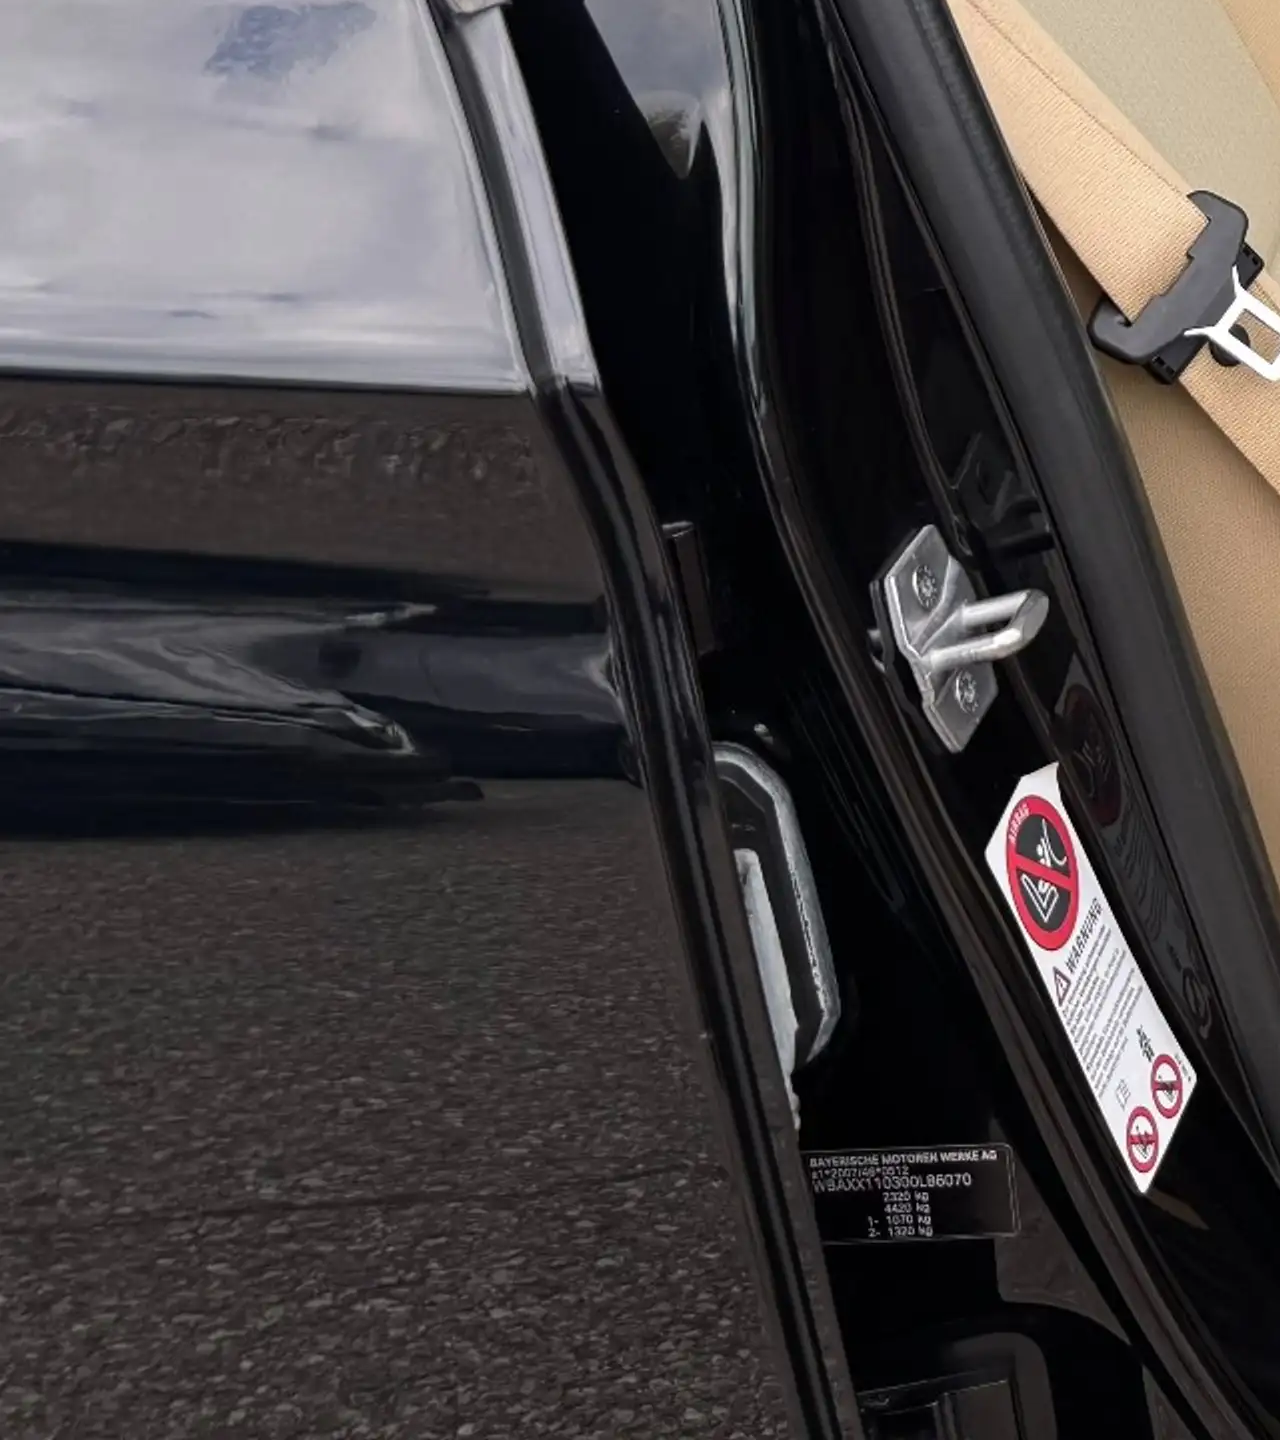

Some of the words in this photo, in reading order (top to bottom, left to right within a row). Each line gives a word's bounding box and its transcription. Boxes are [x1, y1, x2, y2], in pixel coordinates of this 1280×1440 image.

[1065, 897, 1103, 973] WARNUNG
[809, 1154, 879, 1168] BAYERISCHE
[881, 1151, 939, 1166] MOTOREN
[940, 1150, 980, 1163] WERKE
[981, 1149, 998, 1162] AG
